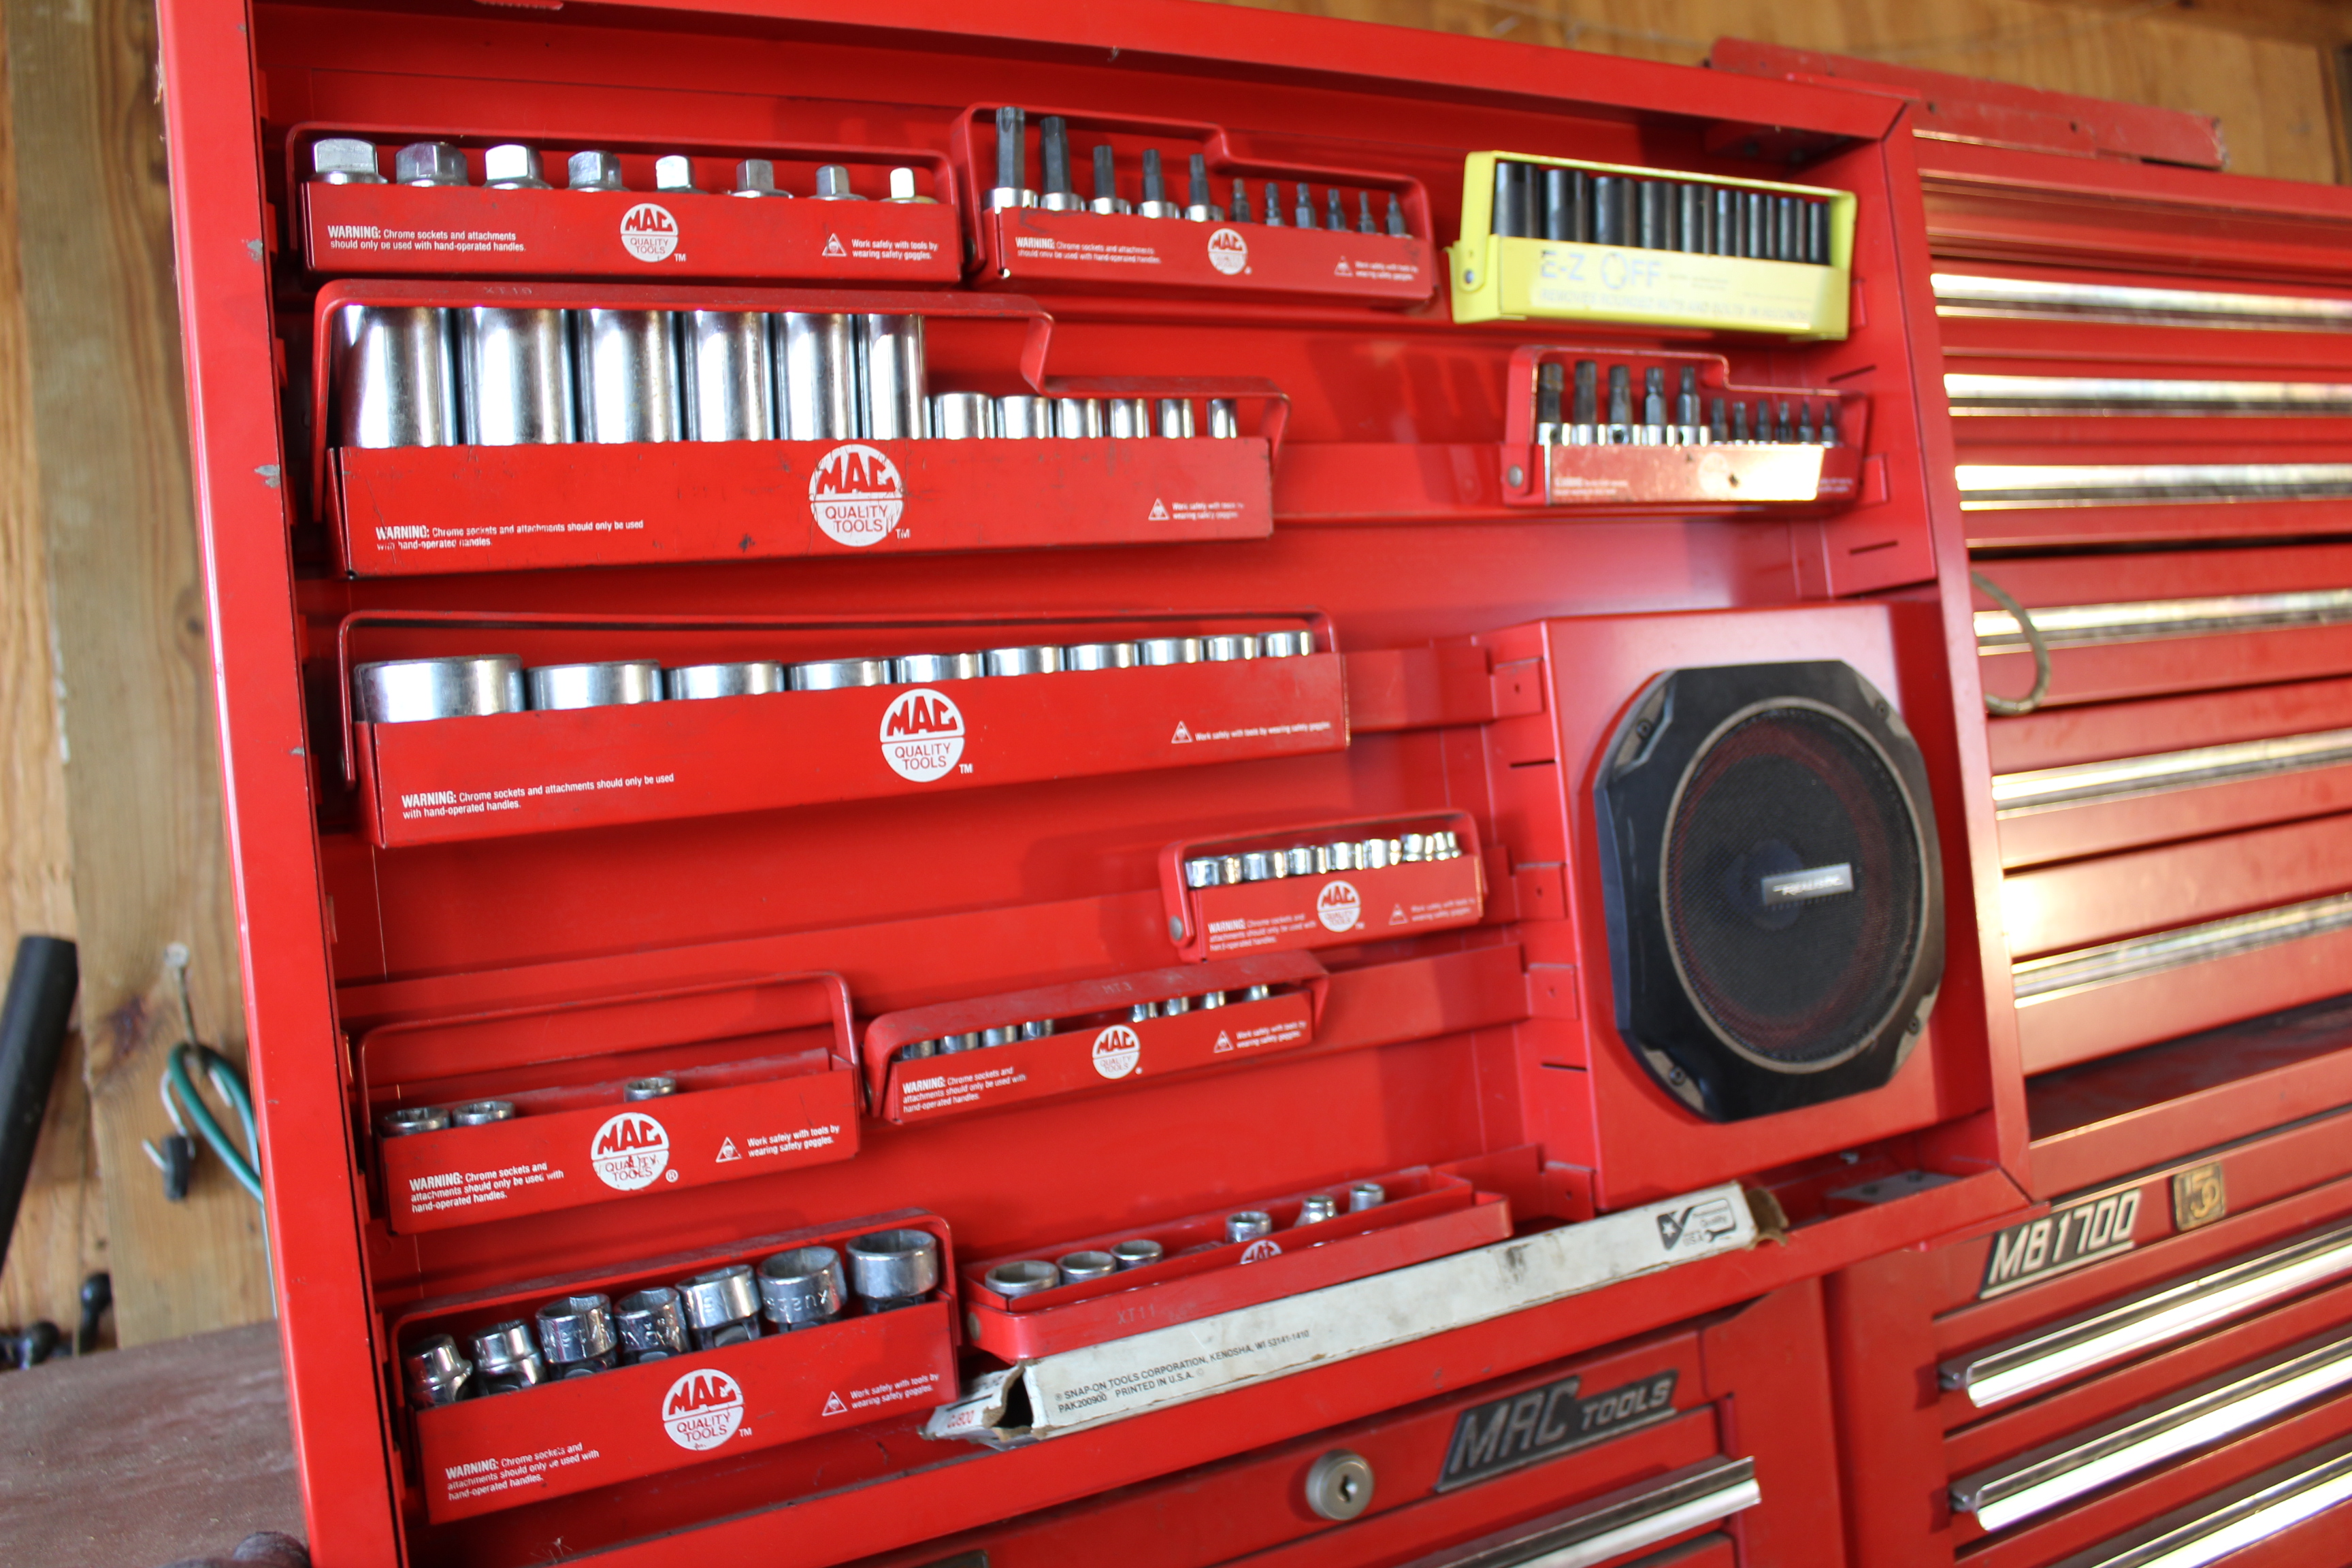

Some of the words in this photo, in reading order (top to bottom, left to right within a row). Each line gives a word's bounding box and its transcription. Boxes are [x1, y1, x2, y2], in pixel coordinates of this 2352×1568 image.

[624, 208, 674, 232] MAC
[328, 225, 381, 239] WARNING:
[383, 229, 415, 239] Chrome
[417, 230, 448, 240] sockets
[451, 231, 465, 240] and
[468, 231, 516, 241] attachments
[630, 238, 669, 246] QUALITY
[851, 239, 870, 248] Work
[872, 240, 892, 250] safely
[894, 241, 909, 249] with
[911, 242, 927, 250] tools
[929, 242, 938, 251] by
[1015, 237, 1056, 249] WARNING:
[1212, 233, 1243, 251] MAC
[330, 240, 358, 249] should
[361, 240, 378, 251] only
[393, 241, 412, 250] used
[414, 242, 431, 250] with
[434, 242, 491, 252] hand-operated
[493, 242, 526, 252] handles.
[636, 245, 666, 255] TOOLS
[852, 250, 879, 259] wearing
[882, 251, 902, 260] safety
[904, 251, 932, 260] goggles.
[1540, 248, 1586, 281] E-Z
[1600, 251, 1662, 289] OFF
[817, 452, 896, 494] MAC
[825, 505, 887, 519] QUALITY
[432, 527, 463, 538] Chrome
[466, 526, 497, 536] sockets
[500, 525, 514, 534] and
[567, 522, 593, 532] should
[595, 521, 612, 532] only
[614, 521, 623, 529] be
[625, 519, 644, 529] used
[834, 519, 883, 533] TOOLS
[886, 696, 958, 736] MAC
[895, 742, 951, 758] QUALITY
[902, 755, 947, 770] TOOLS
[959, 764, 973, 774] TM
[402, 791, 457, 808] WARNING:
[459, 791, 491, 802] Chrome
[493, 787, 525, 800] sockets
[527, 785, 543, 796] and
[545, 781, 594, 794] attachments
[596, 778, 623, 790] should
[625, 776, 642, 787] only
[644, 774, 654, 785] be
[655, 772, 674, 783] used
[402, 809, 422, 820] with
[424, 802, 485, 817] hand-operated
[487, 799, 521, 811] handles.
[1322, 885, 1356, 907] MAC
[1096, 1030, 1134, 1054] MAC
[902, 1076, 946, 1094] WARNING:
[947, 1075, 973, 1086] Chrome
[974, 1070, 999, 1081] sockets
[1000, 1066, 1014, 1076] and
[903, 1090, 945, 1104] attachments
[946, 1085, 968, 1096] should
[969, 1083, 984, 1092] only
[985, 1080, 994, 1088] be
[995, 1078, 1010, 1087] used
[1011, 1074, 1026, 1083] with
[903, 1098, 951, 1113] hand-operated
[953, 1093, 980, 1104] handles.
[598, 1119, 662, 1154] MAC
[747, 1137, 768, 1148] Work
[793, 1129, 809, 1139] with
[811, 1126, 829, 1137] tools
[830, 1124, 840, 1134] by
[748, 1146, 779, 1158] wearing
[779, 1141, 802, 1152] safety
[804, 1137, 834, 1149] goggles.
[409, 1172, 463, 1192] WARNING:
[465, 1171, 497, 1183] Chrome
[499, 1164, 530, 1178] sockets
[532, 1161, 547, 1173] and
[613, 1166, 653, 1181] TOOLS
[411, 1186, 462, 1203] attachments
[463, 1181, 491, 1194] should
[493, 1178, 511, 1190] only
[513, 1175, 523, 1186] be
[546, 1169, 564, 1181] with
[412, 1197, 471, 1213] hand-operated
[473, 1189, 508, 1203] handles.
[1988, 1188, 2142, 1284] MB1700
[1064, 1382, 1107, 1400] SNAP-ON
[1109, 1373, 1140, 1388] TOOLS
[1142, 1356, 1208, 1380] CORPORATION,
[1210, 1345, 1254, 1362] KENOSHA,
[1256, 1341, 1267, 1350] WI
[1268, 1330, 1309, 1348] 53141-1410
[668, 1375, 737, 1415] MAC
[851, 1388, 870, 1399] Work
[871, 1383, 892, 1394] safely
[894, 1379, 910, 1390] with
[911, 1375, 928, 1386] tools
[930, 1373, 939, 1382] by
[851, 1396, 881, 1409] wearing
[881, 1391, 904, 1403] safety
[904, 1385, 933, 1398] goggles.
[1058, 1393, 1107, 1413] PAK200900
[1115, 1381, 1155, 1398] PRINTED
[1157, 1379, 1167, 1387] IN
[1169, 1372, 1194, 1385] U.S.A.
[677, 1412, 730, 1433] QUALITY
[686, 1425, 727, 1441] TOOLS
[739, 1427, 752, 1437] TM
[1449, 1376, 1580, 1475] MAC
[1582, 1377, 1672, 1431] TOOLS
[445, 1458, 499, 1480] WARNING:
[500, 1454, 533, 1468] Chrome
[567, 1441, 583, 1454] and
[447, 1472, 498, 1490] attachments
[500, 1465, 527, 1478] should
[529, 1461, 546, 1473] only
[561, 1454, 580, 1466] used
[581, 1450, 600, 1461] with
[448, 1480, 508, 1501] hand-operated
[510, 1473, 543, 1488] handles.
